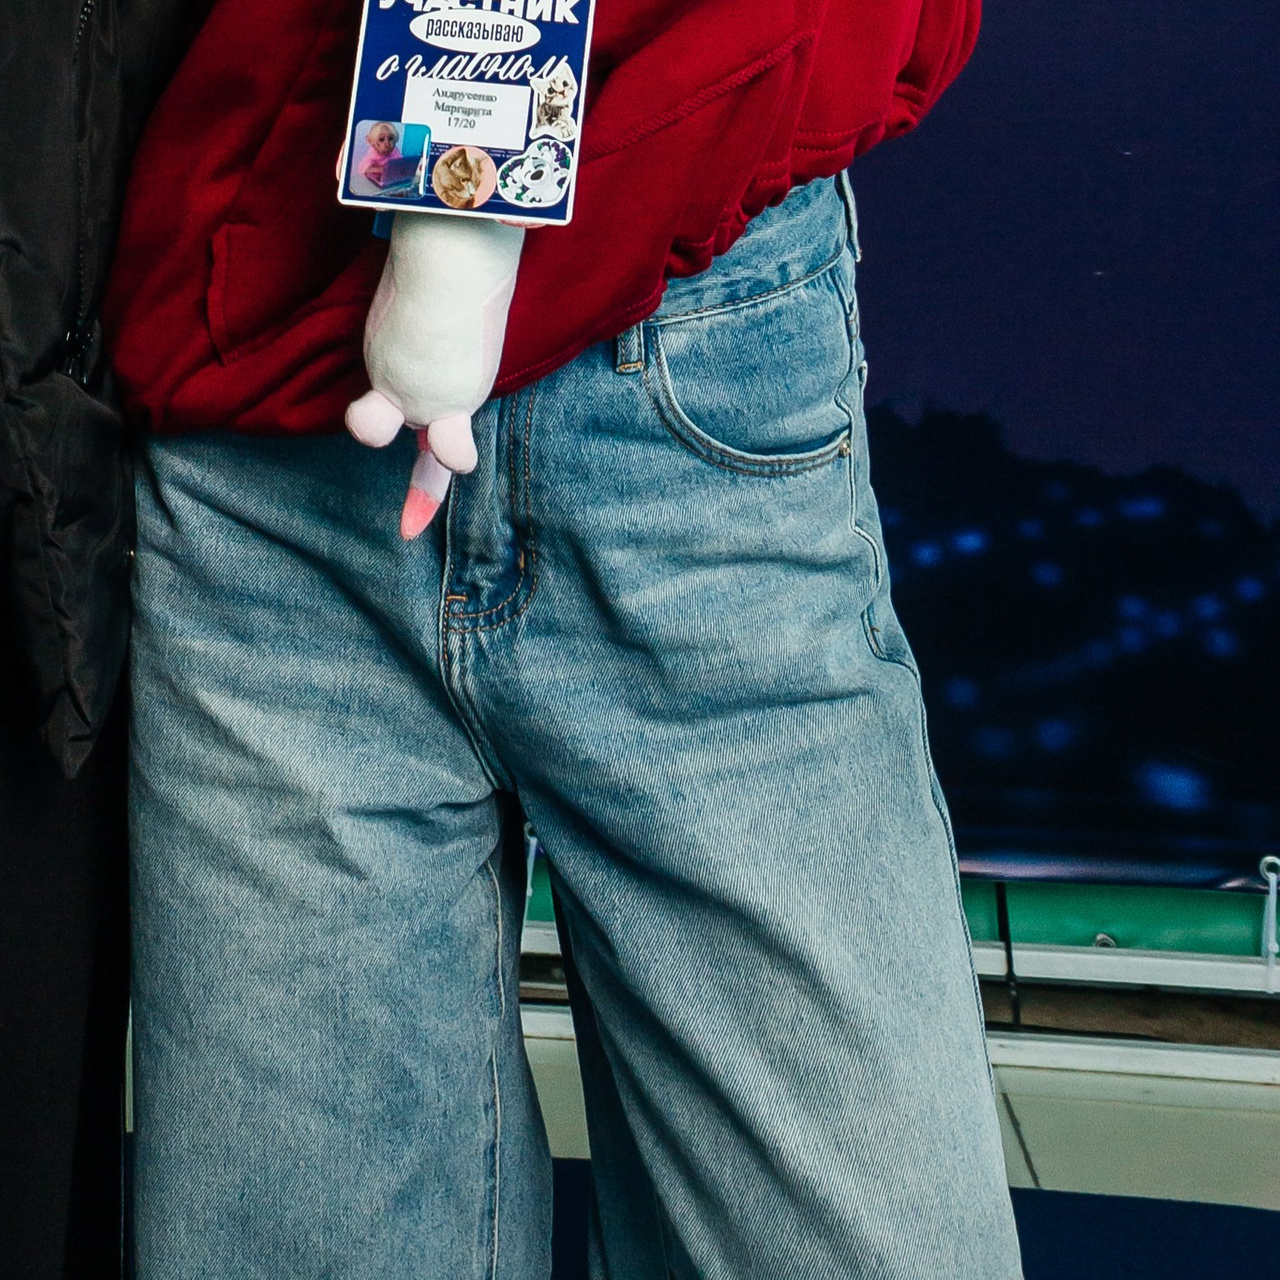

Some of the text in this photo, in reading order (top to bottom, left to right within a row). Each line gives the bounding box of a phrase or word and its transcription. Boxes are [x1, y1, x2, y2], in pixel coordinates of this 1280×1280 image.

[424, 19, 525, 44] рассказываю
[376, 53, 399, 81] о
[433, 101, 493, 117] Маргарита
[446, 117, 476, 129] 17/20
